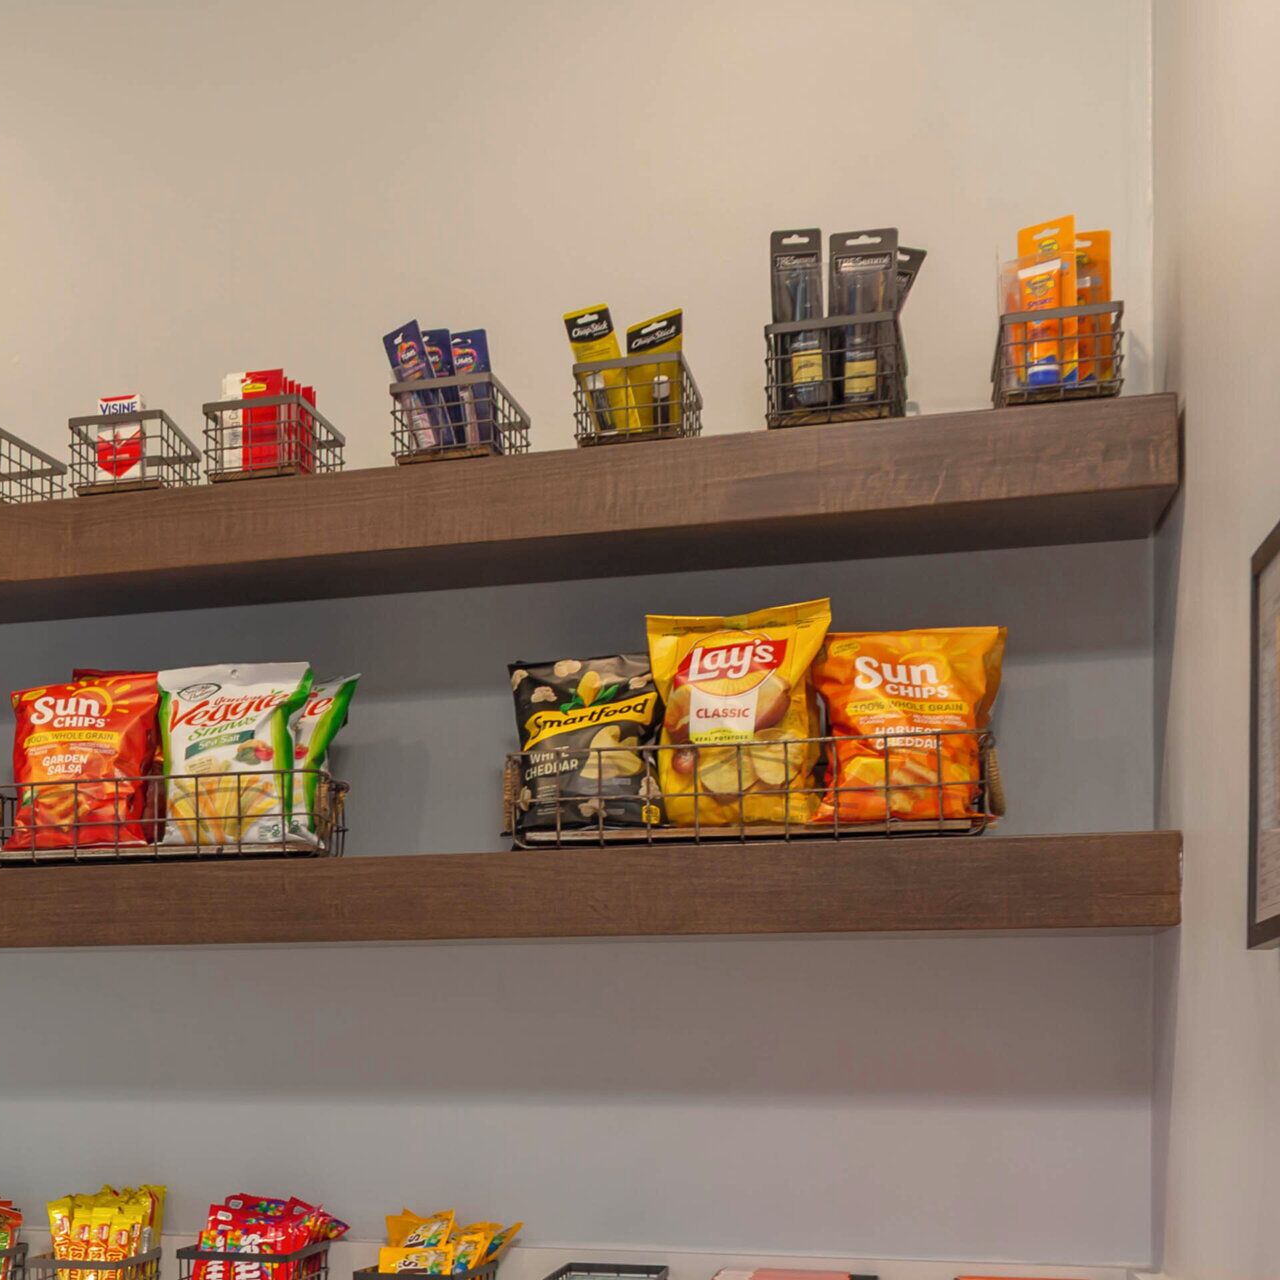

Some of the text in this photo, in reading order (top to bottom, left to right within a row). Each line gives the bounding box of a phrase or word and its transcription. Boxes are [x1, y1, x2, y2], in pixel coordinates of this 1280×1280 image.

[572, 320, 608, 338] ChapStick
[631, 326, 676, 349] ChapStick
[99, 401, 138, 415] VISINE
[687, 638, 775, 681] Lay's
[854, 656, 939, 690] Sun
[885, 684, 950, 698] CHIPS
[30, 696, 101, 725] Sun
[696, 707, 752, 719] CLASSIC
[890, 700, 925, 711] WHOLE
[928, 703, 964, 712] GRAIN
[169, 694, 288, 733] Veggie
[532, 698, 649, 740] Smartfood
[53, 716, 106, 728] CHIPS
[85, 732, 114, 741] GRAIN
[198, 735, 240, 750] Sea Salt
[42, 754, 88, 766] GARDEN
[47, 764, 82, 775] SALSA
